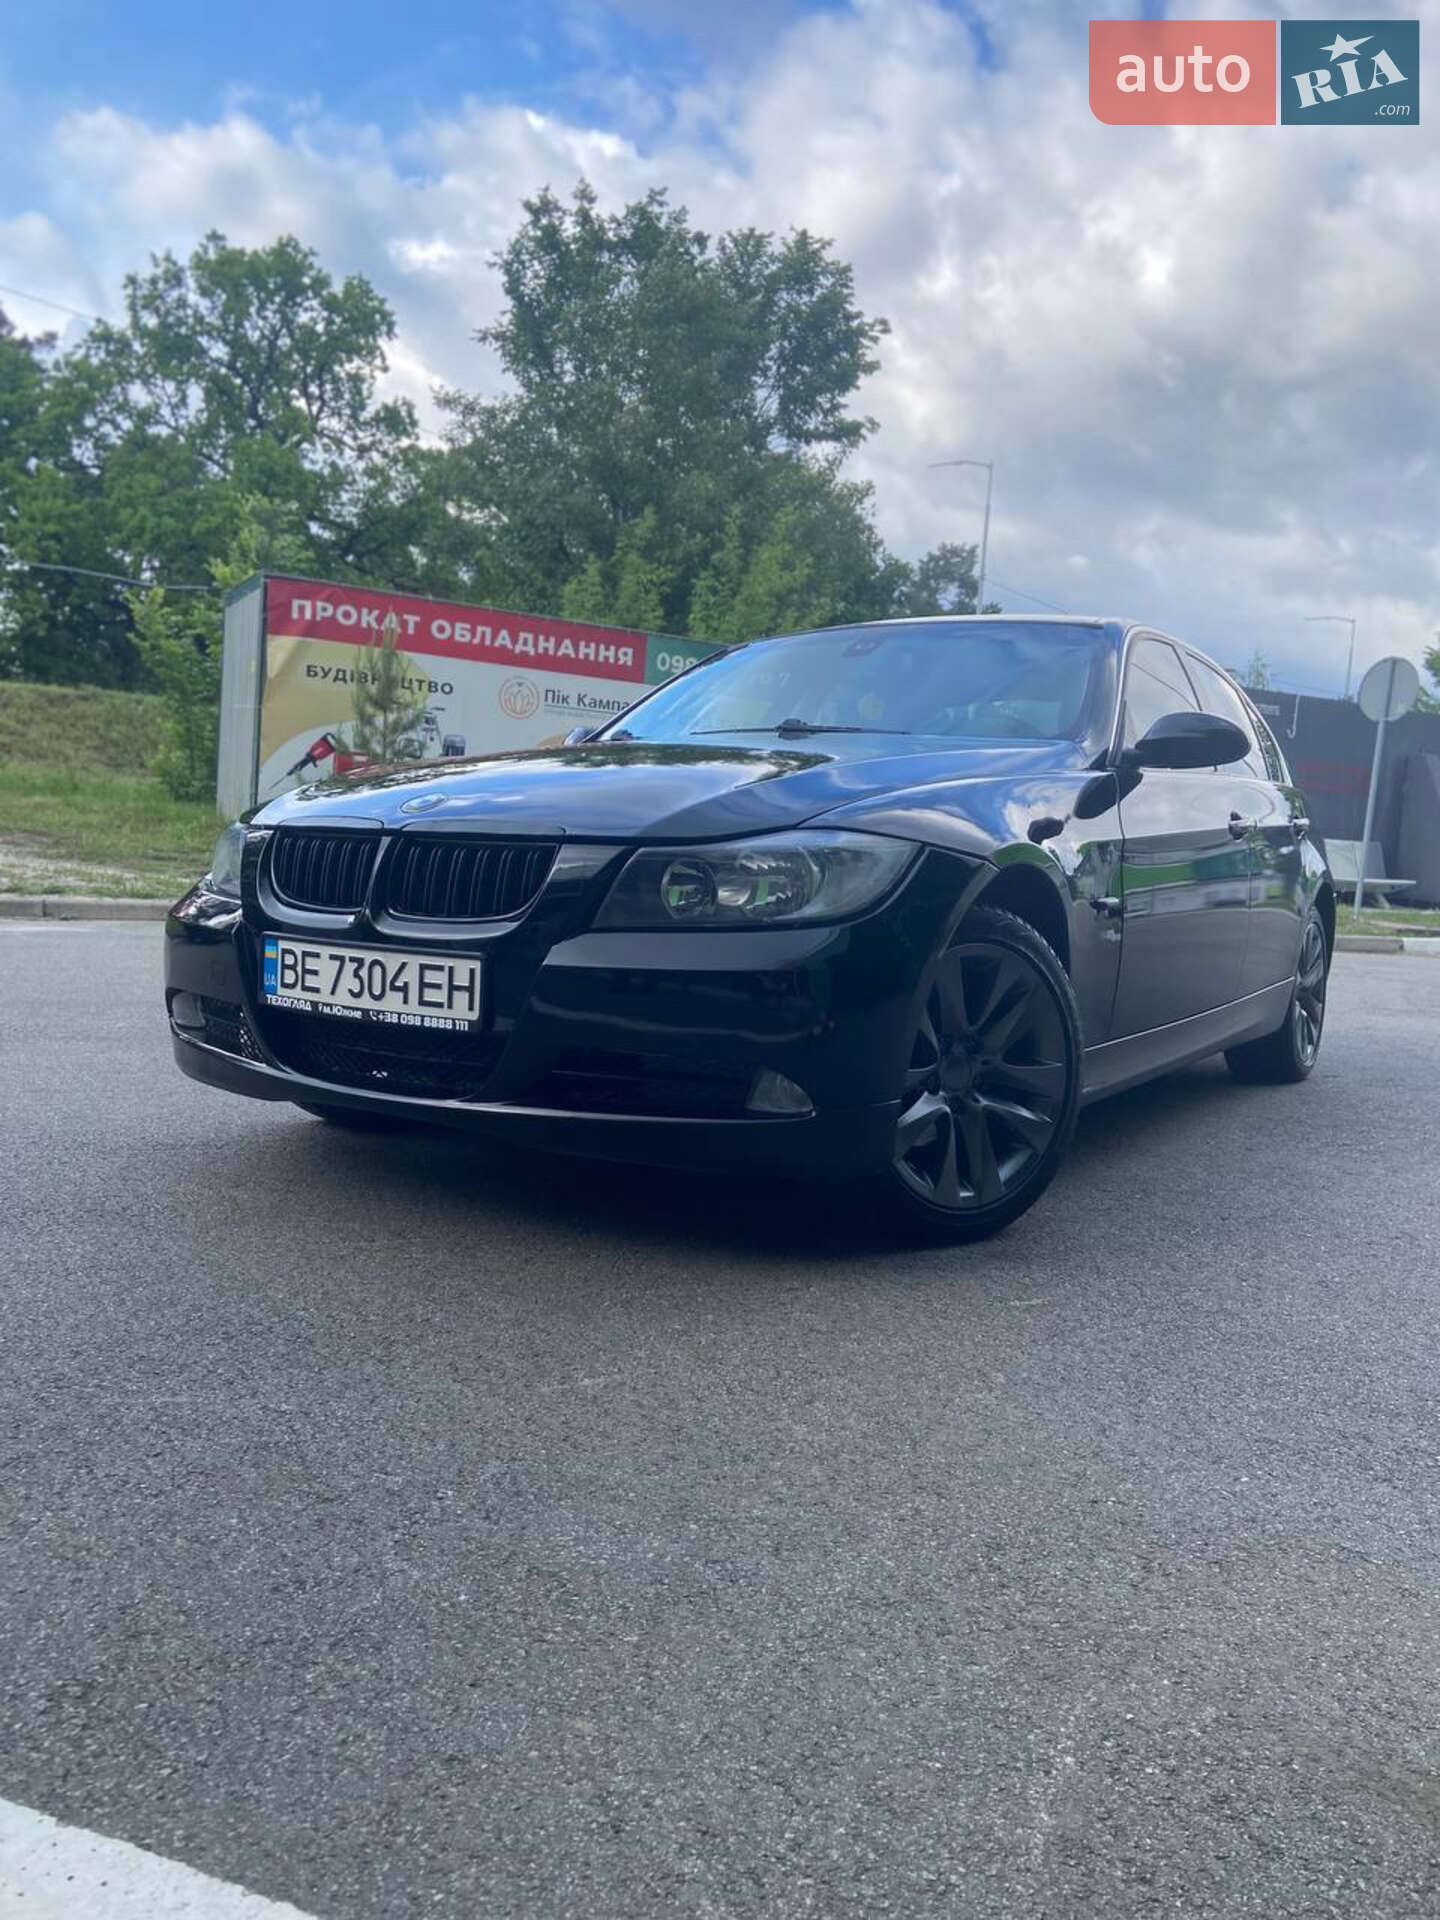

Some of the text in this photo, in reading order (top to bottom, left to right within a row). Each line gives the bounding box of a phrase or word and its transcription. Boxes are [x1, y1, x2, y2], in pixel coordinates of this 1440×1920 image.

[290, 599, 634, 667] ПРОКАТ ОБЛАДНАННЯ
[544, 687, 570, 706] Пік
